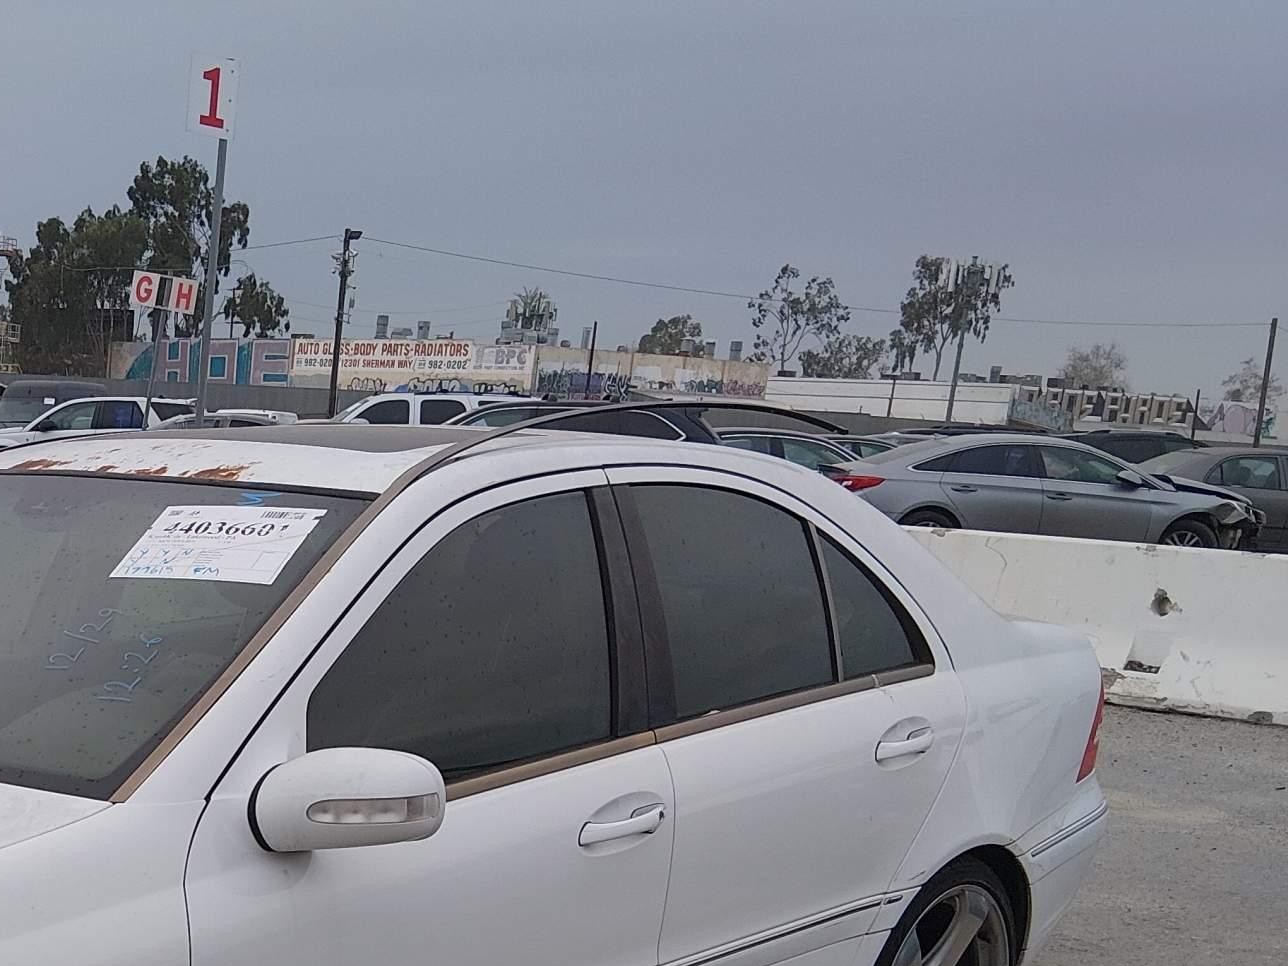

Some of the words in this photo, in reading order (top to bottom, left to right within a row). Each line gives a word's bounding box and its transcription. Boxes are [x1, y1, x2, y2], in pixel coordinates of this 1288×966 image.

[200, 66, 224, 129] 1
[136, 275, 153, 303] G
[175, 282, 193, 310] H
[297, 342, 320, 355] AUTO
[361, 359, 397, 370] SHERMAN
[397, 360, 414, 369] WAY
